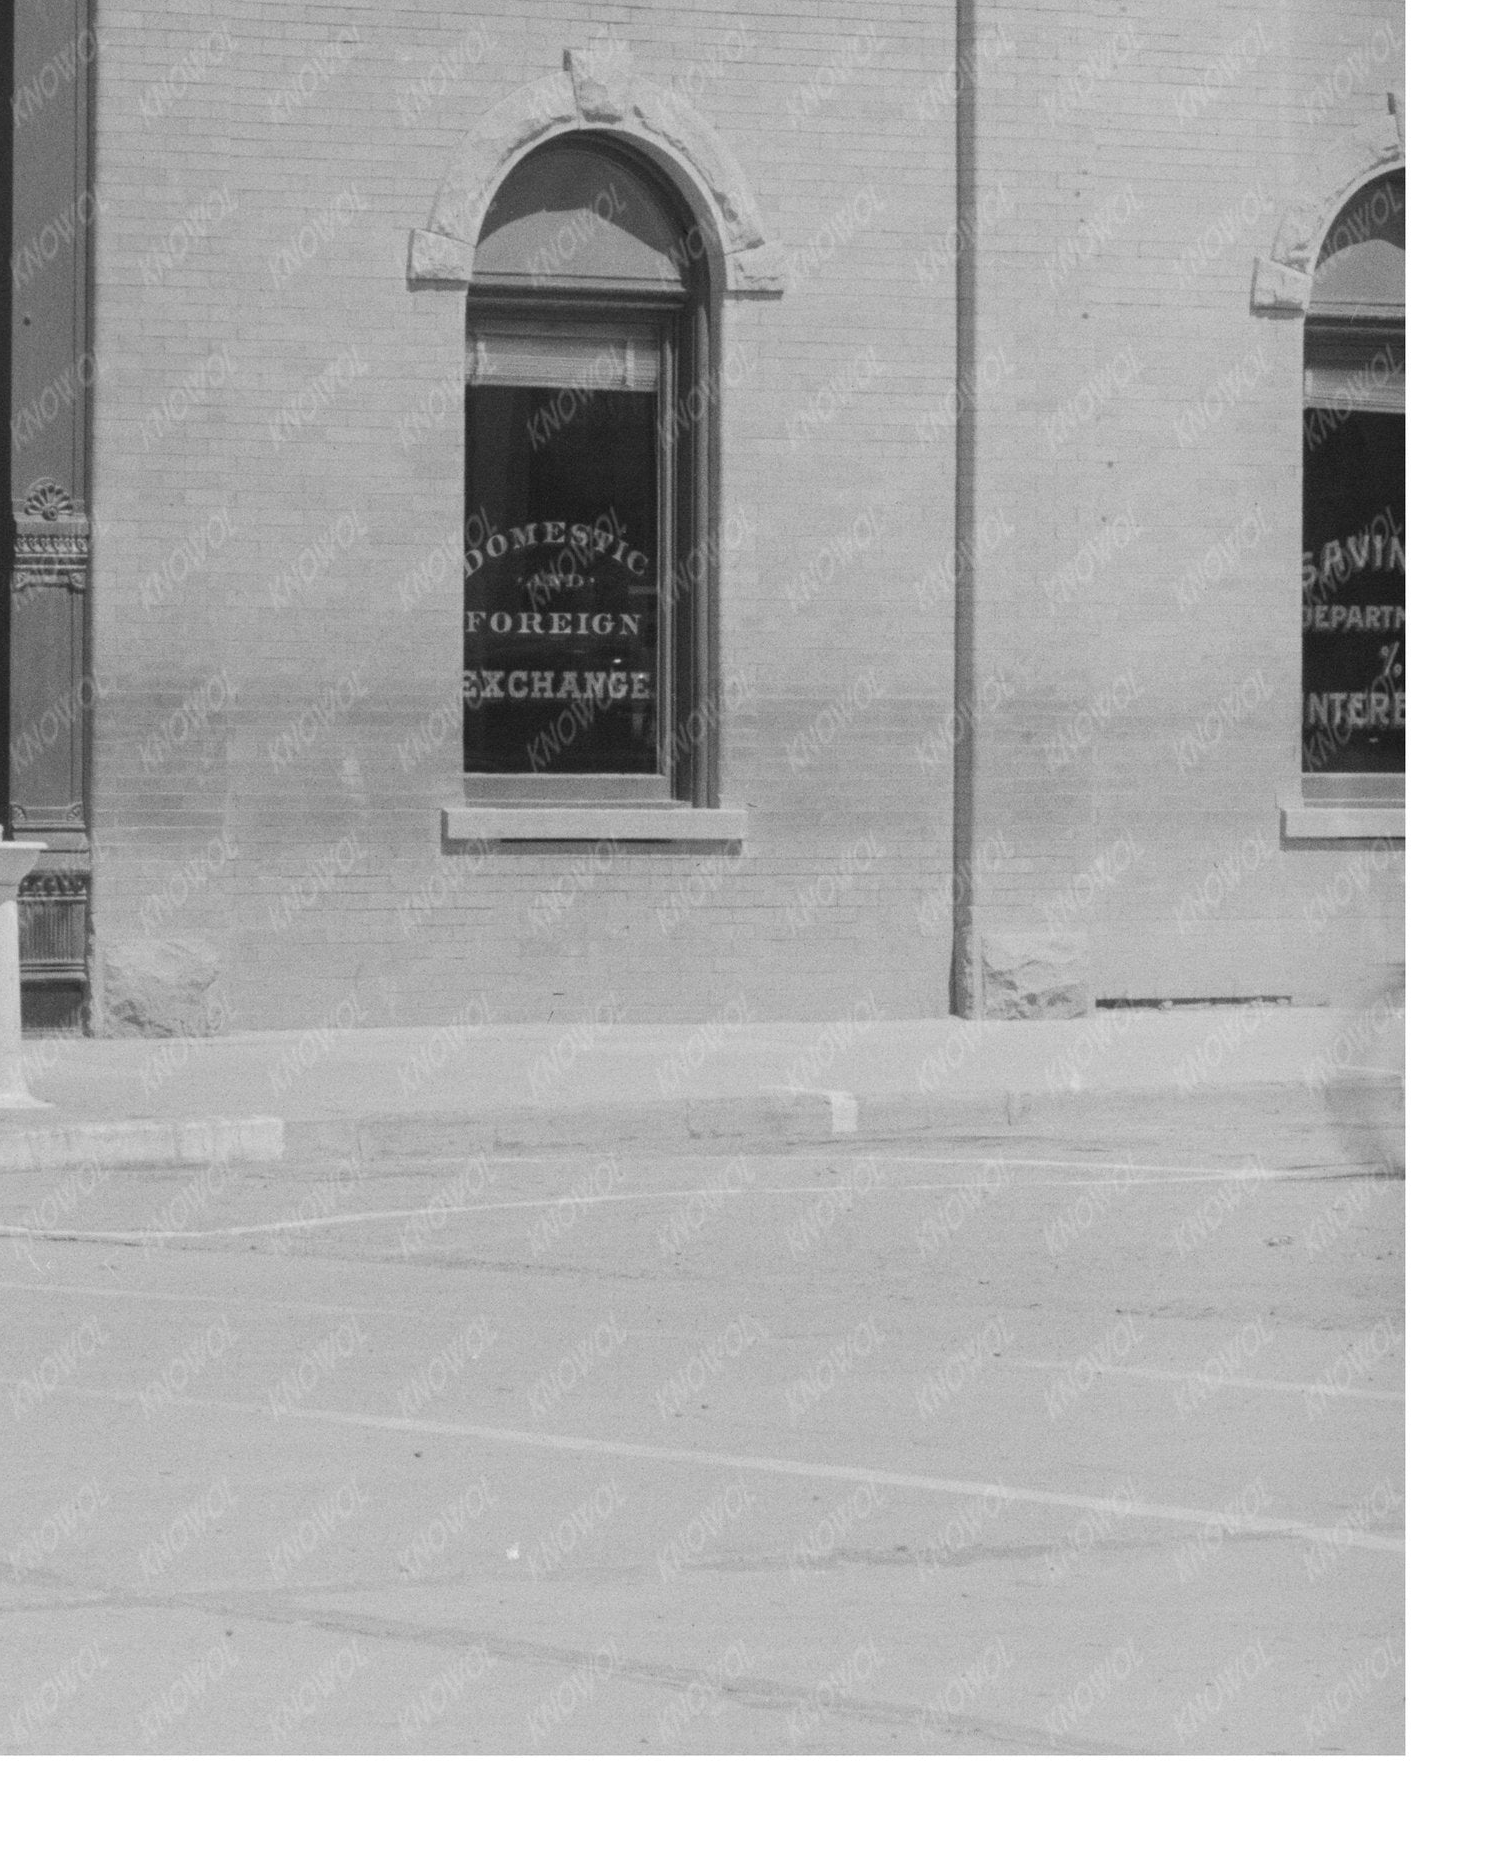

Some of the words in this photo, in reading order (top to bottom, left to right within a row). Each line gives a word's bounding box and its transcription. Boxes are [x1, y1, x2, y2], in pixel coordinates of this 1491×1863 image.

[464, 521, 649, 578] DOMESTIC
[465, 611, 642, 635] FOREIGN
[463, 670, 651, 700] EXCHANGE
